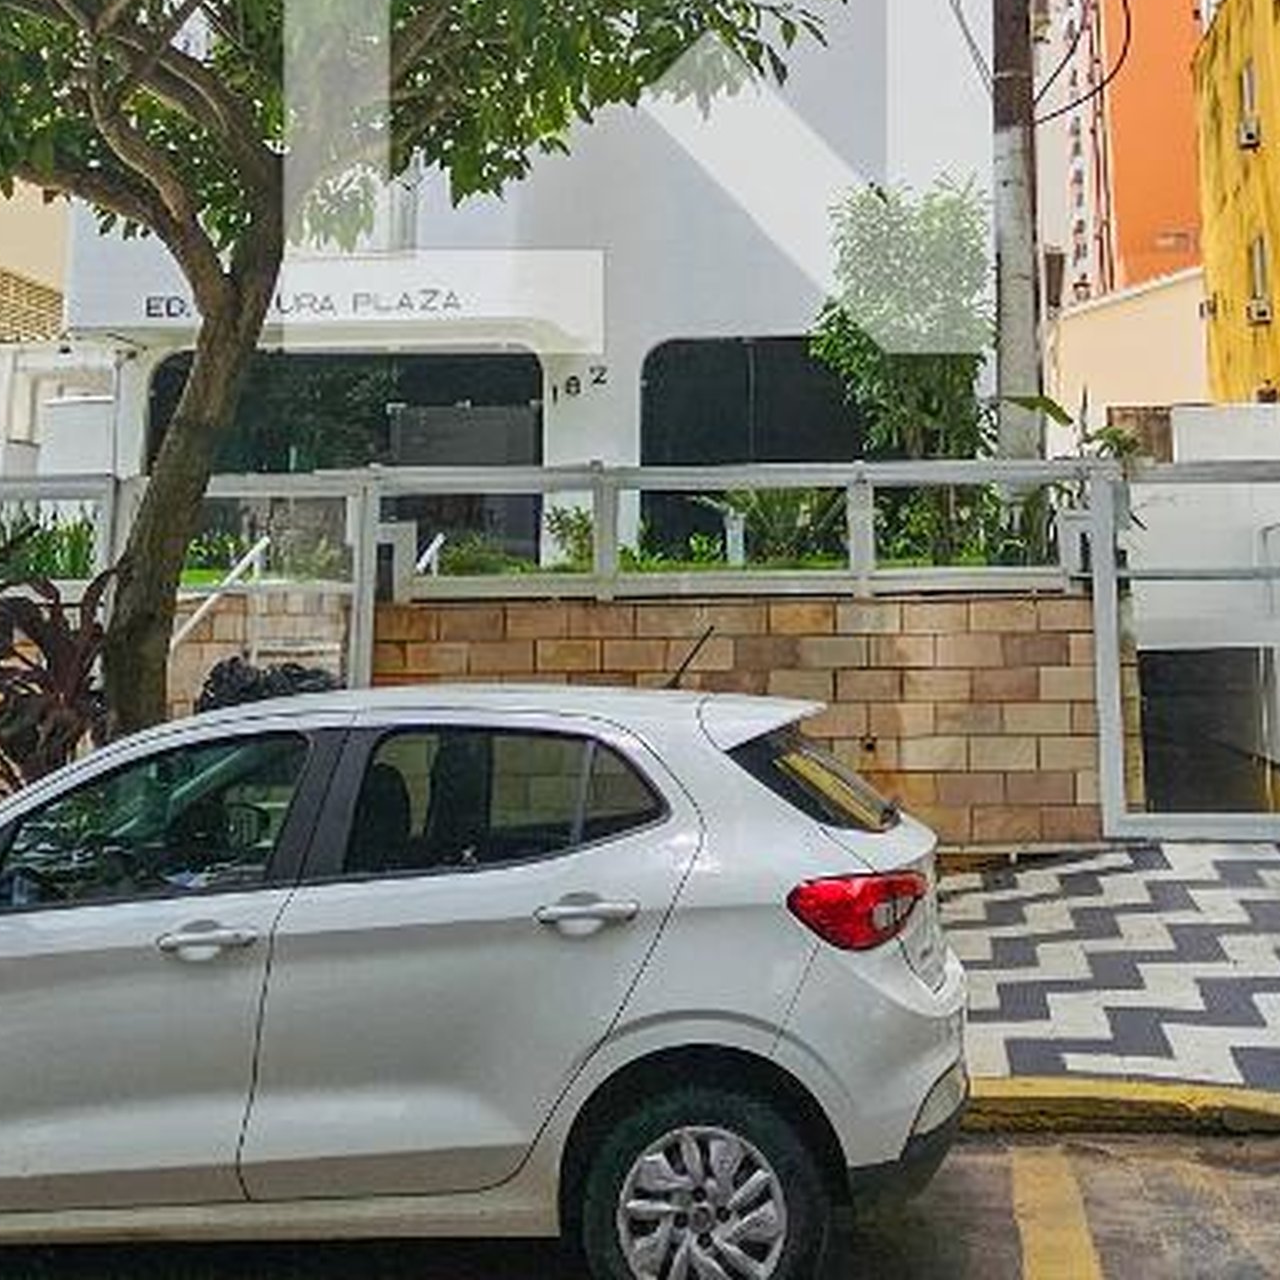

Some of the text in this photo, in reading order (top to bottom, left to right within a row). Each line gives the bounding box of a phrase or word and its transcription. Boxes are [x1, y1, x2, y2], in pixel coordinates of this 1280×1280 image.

[145, 295, 192, 318] ED.
[352, 288, 462, 313] PLAZA
[551, 365, 608, 406] 182
